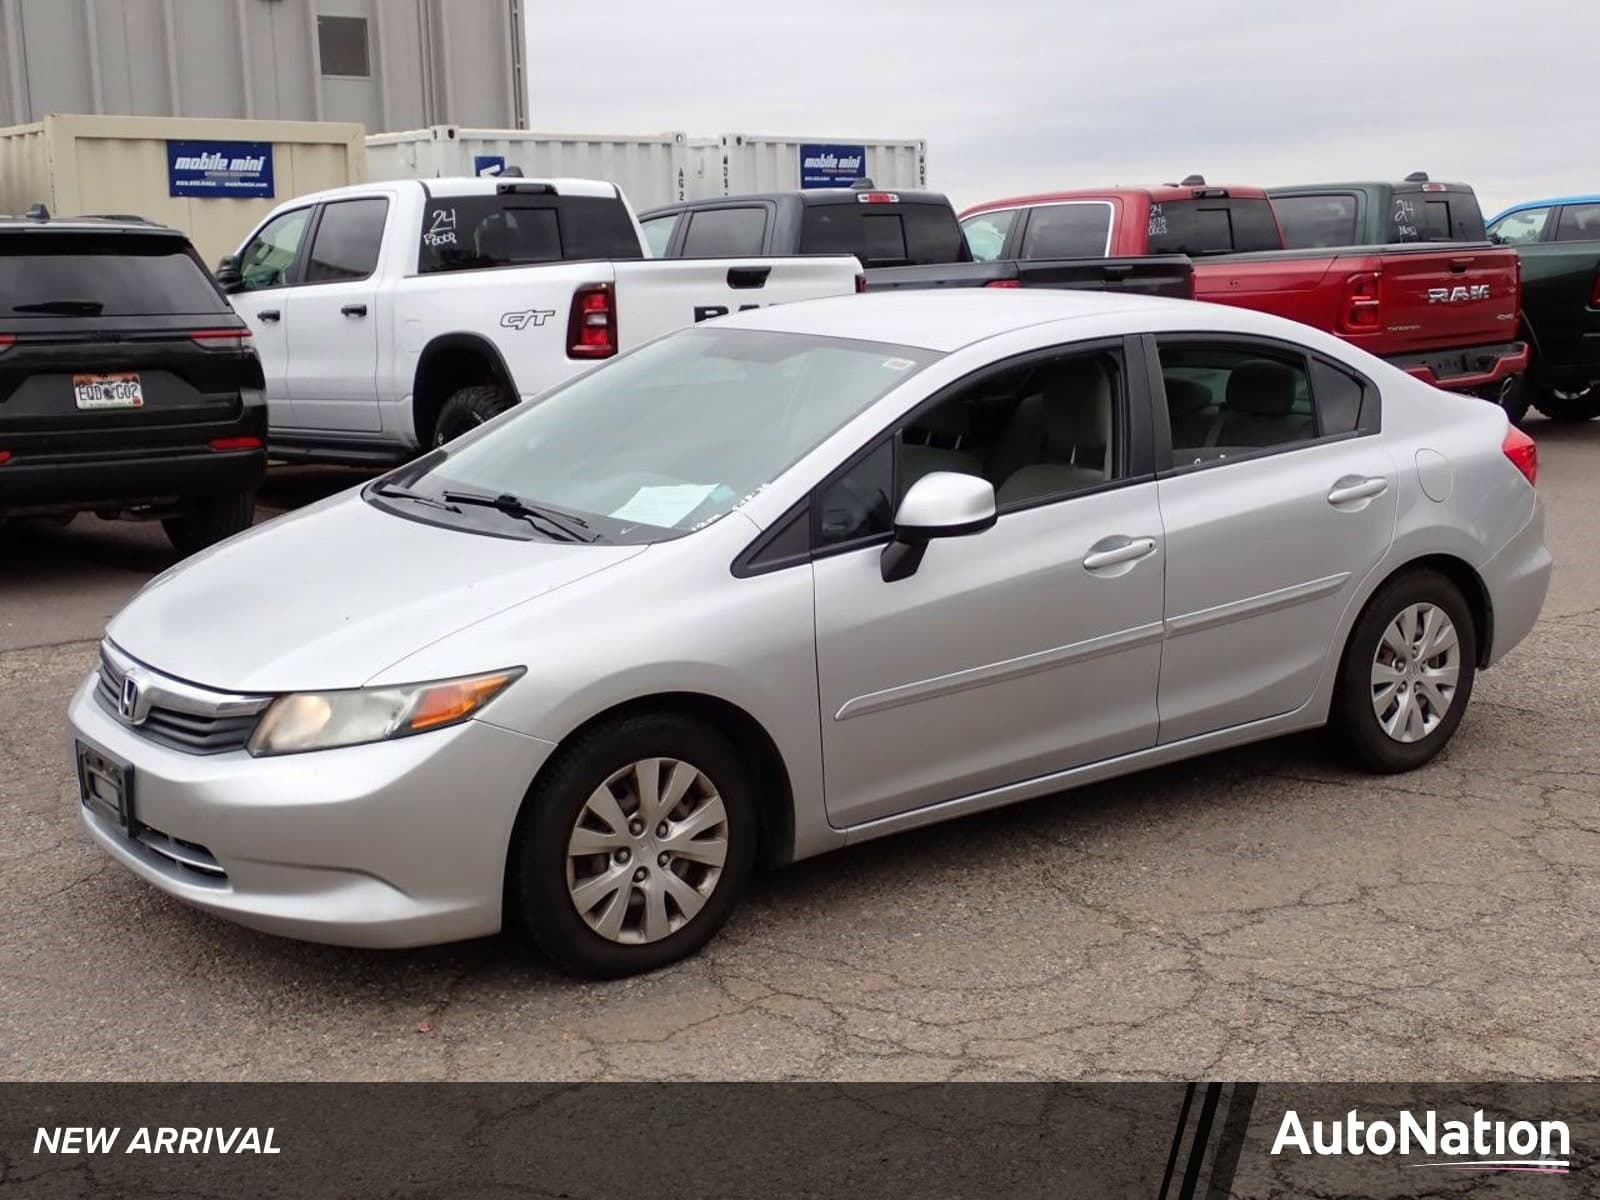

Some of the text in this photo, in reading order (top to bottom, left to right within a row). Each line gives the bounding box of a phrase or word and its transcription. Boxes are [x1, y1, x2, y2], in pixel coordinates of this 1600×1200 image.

[174, 152, 267, 172] mobile mini
[804, 153, 862, 169] mobile mini
[430, 208, 456, 232] 24
[1394, 199, 1415, 223] 24
[1428, 284, 1490, 304] RAM
